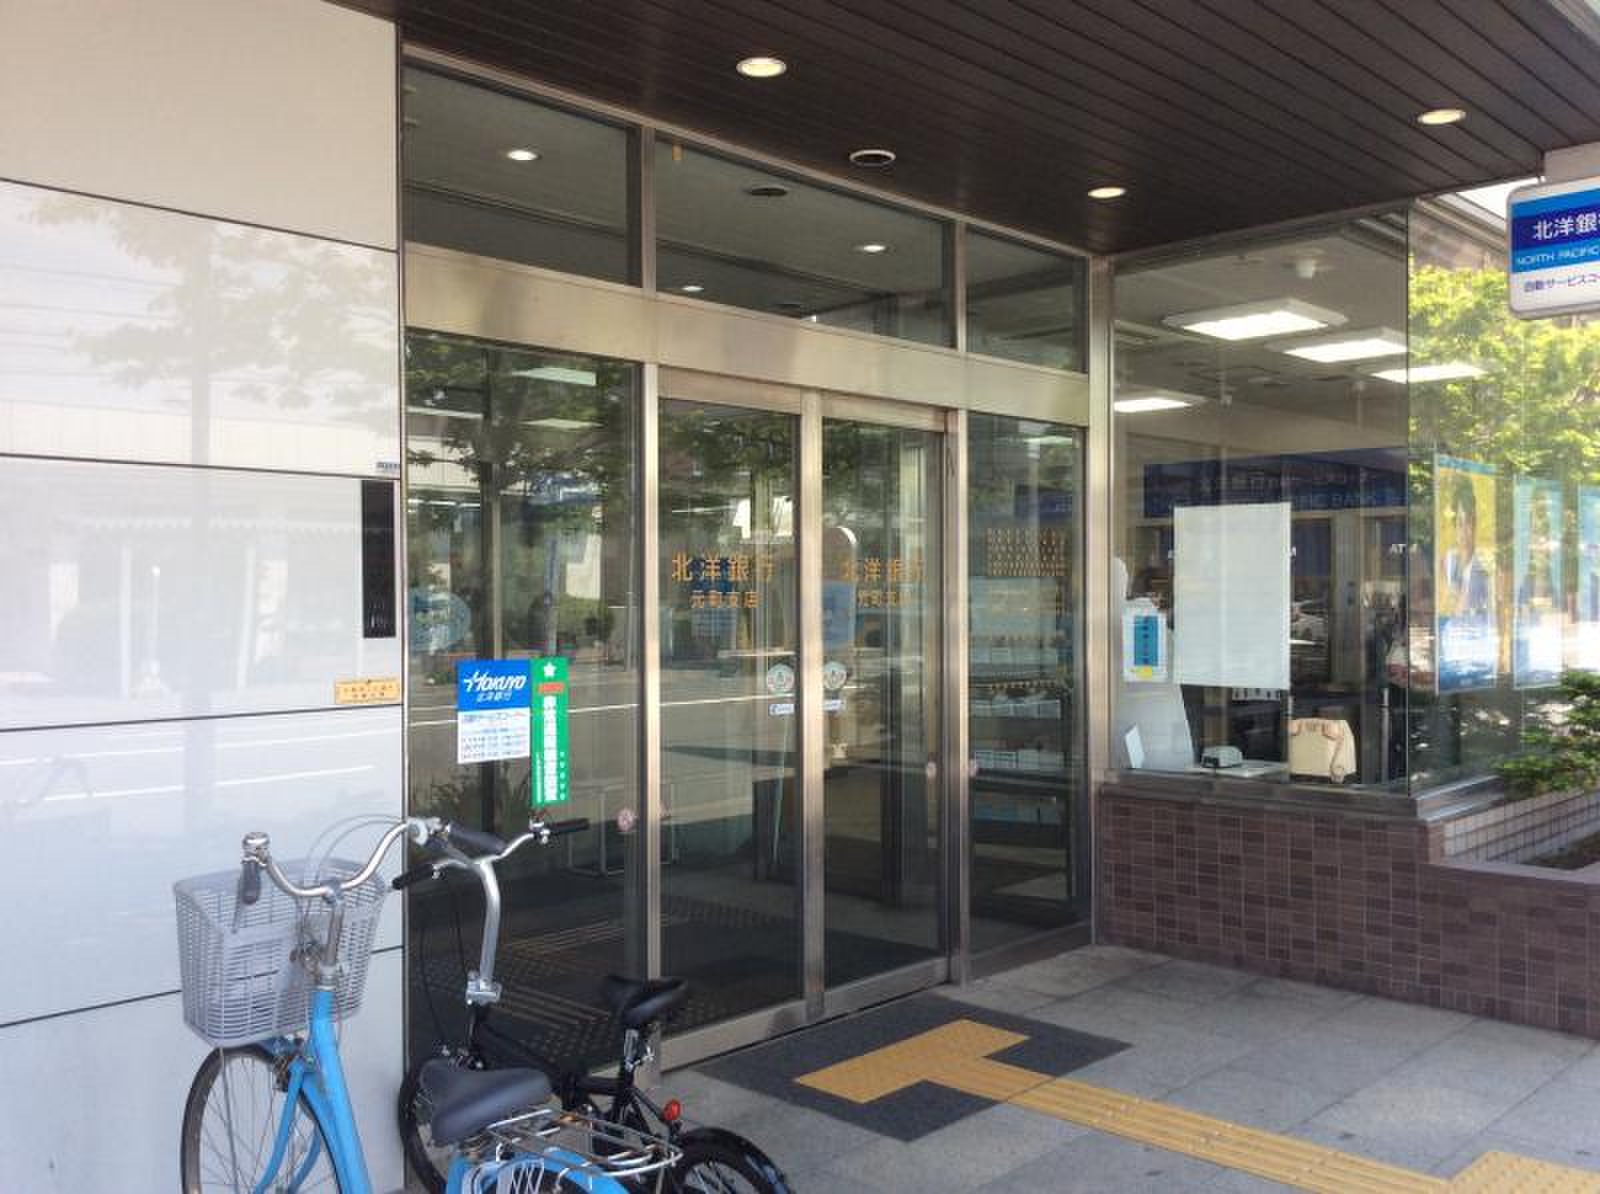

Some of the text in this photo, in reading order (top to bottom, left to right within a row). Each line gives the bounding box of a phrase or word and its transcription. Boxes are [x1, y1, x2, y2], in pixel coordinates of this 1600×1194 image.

[1532, 212, 1600, 240] 北洋銀
[1518, 251, 1555, 265] NORTH
